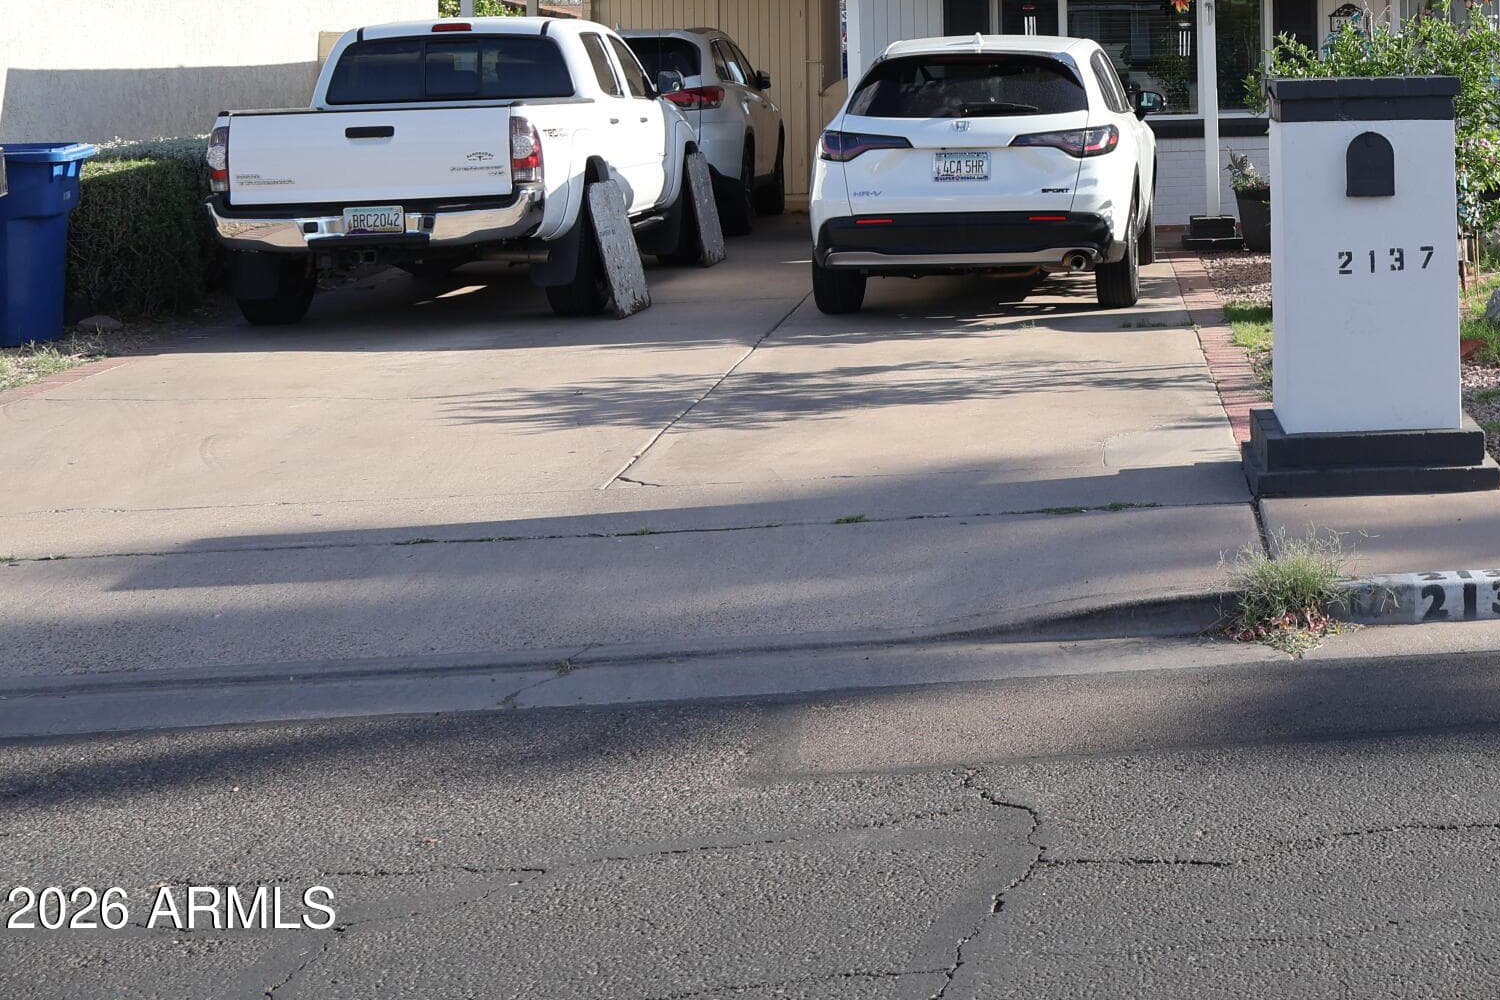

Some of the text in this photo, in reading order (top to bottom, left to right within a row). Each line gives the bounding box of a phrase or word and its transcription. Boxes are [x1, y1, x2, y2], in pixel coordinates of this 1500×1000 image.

[943, 160, 984, 173] 4CA 5HR
[352, 212, 400, 228] BRC2042
[1338, 246, 1434, 275] 2137
